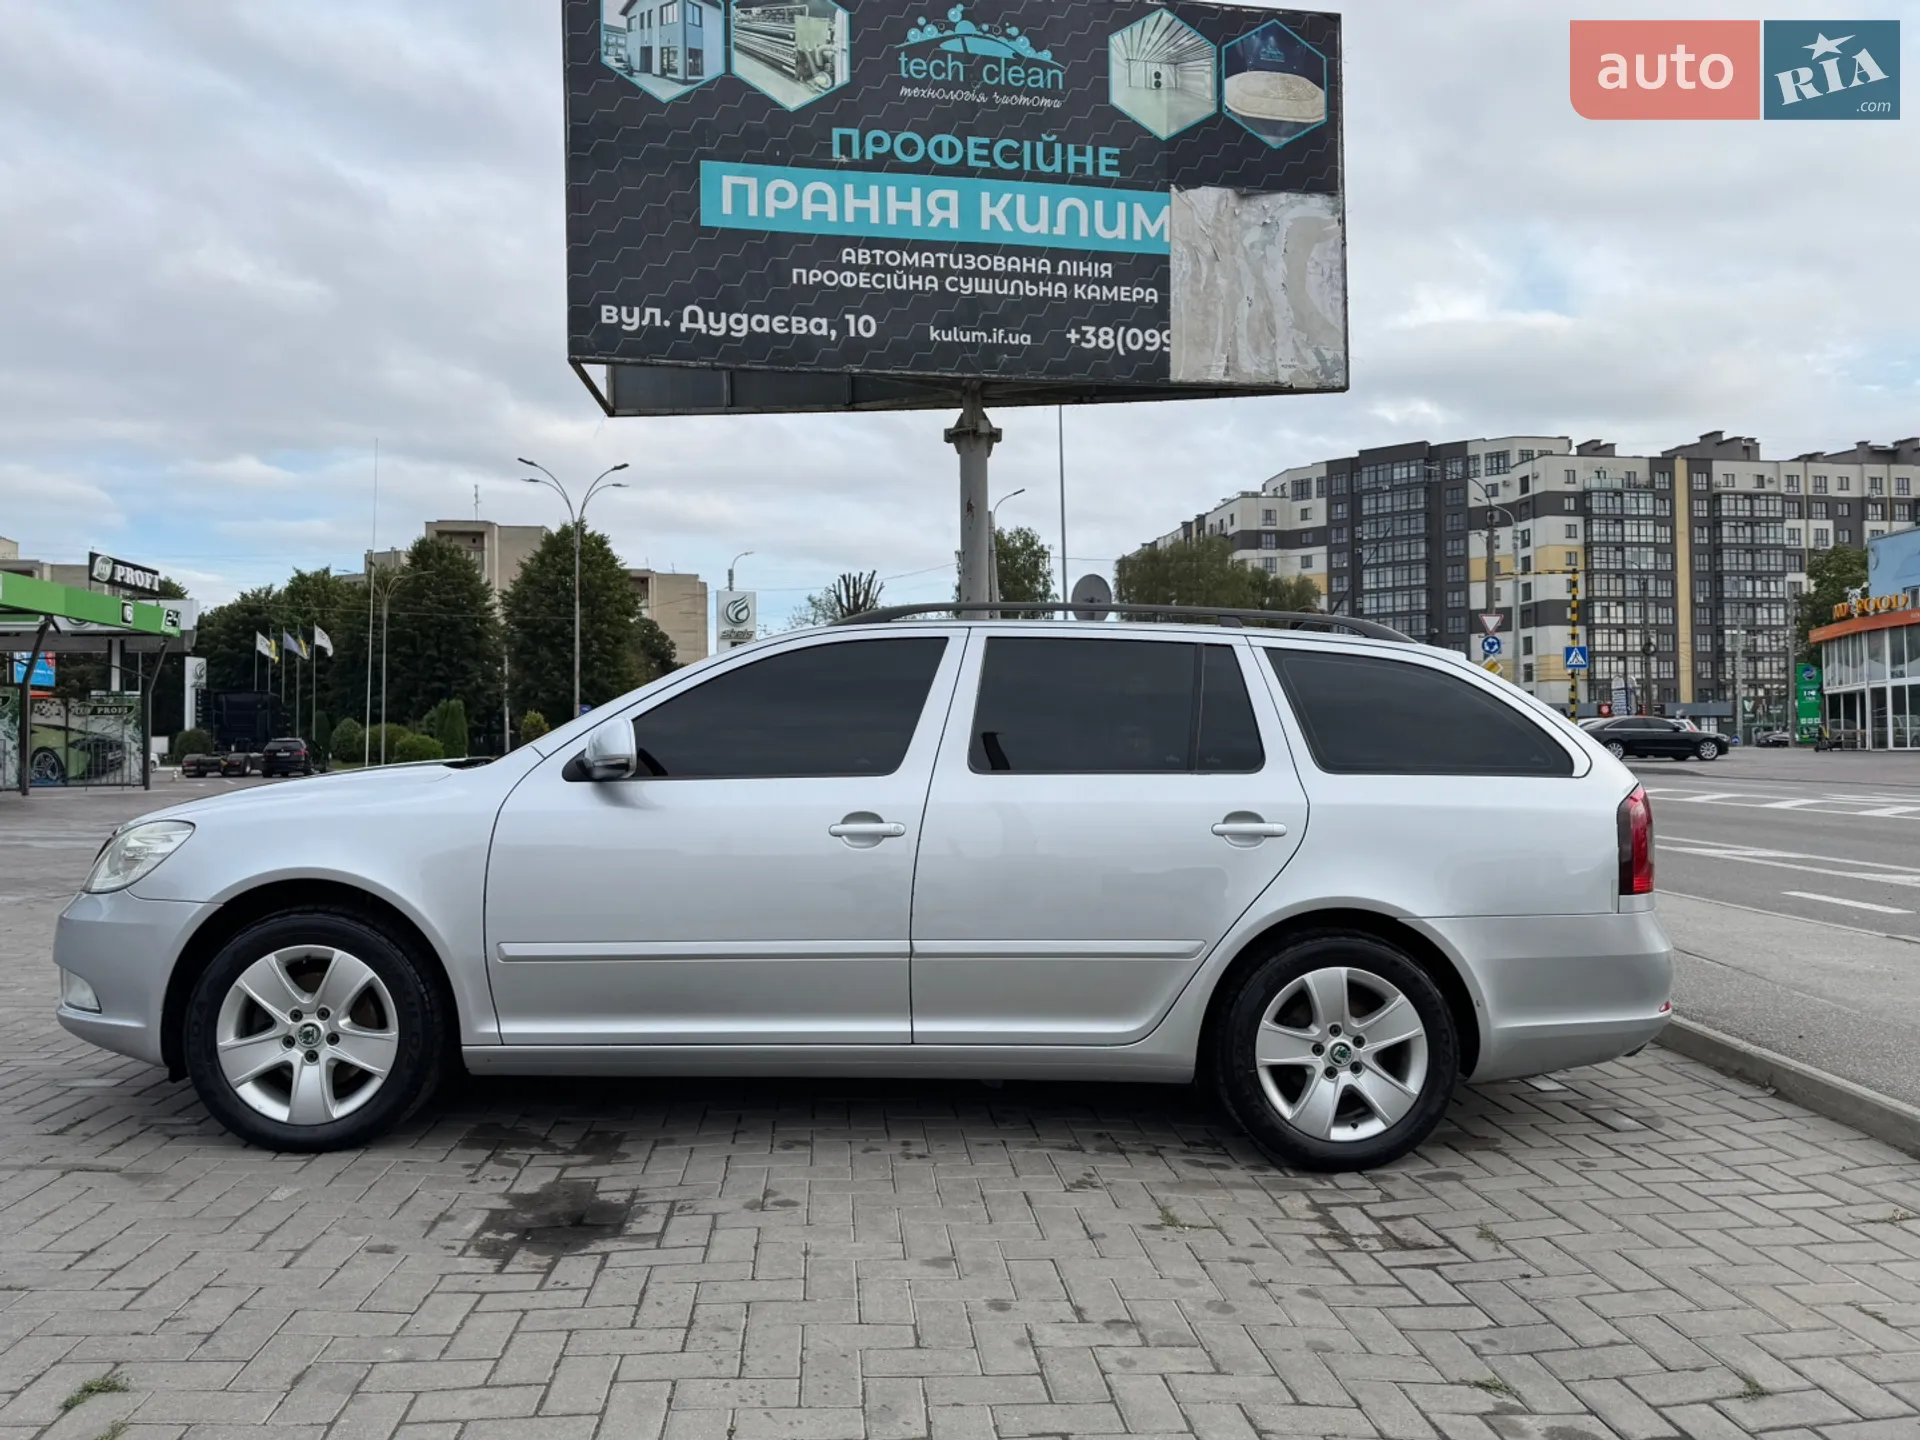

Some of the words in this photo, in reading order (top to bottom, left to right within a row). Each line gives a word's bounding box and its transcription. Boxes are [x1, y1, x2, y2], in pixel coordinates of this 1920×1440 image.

[898, 51, 964, 82] tech
[982, 57, 1063, 90] clean
[899, 85, 988, 103] технологія
[993, 91, 1062, 109] чистоти
[831, 127, 1121, 177] ПРОФЕСІЙНЕ
[721, 175, 959, 229] ПРАННЯ
[980, 191, 1170, 243] КИЛИМ
[841, 247, 1051, 274] АВТОМАТИЗОВАНА
[1057, 260, 1112, 278] ЛІНІЯ
[792, 268, 939, 291] ПРОФЕСІЙНА
[945, 275, 1067, 298] СУШИЛЬНА
[1074, 284, 1158, 303] КАМЕРА
[601, 304, 671, 331] вул.
[680, 305, 837, 341] Дудаєва,
[845, 314, 877, 338] 10
[929, 325, 1031, 345] kulum.if.ua
[114, 564, 159, 591] PROFI
